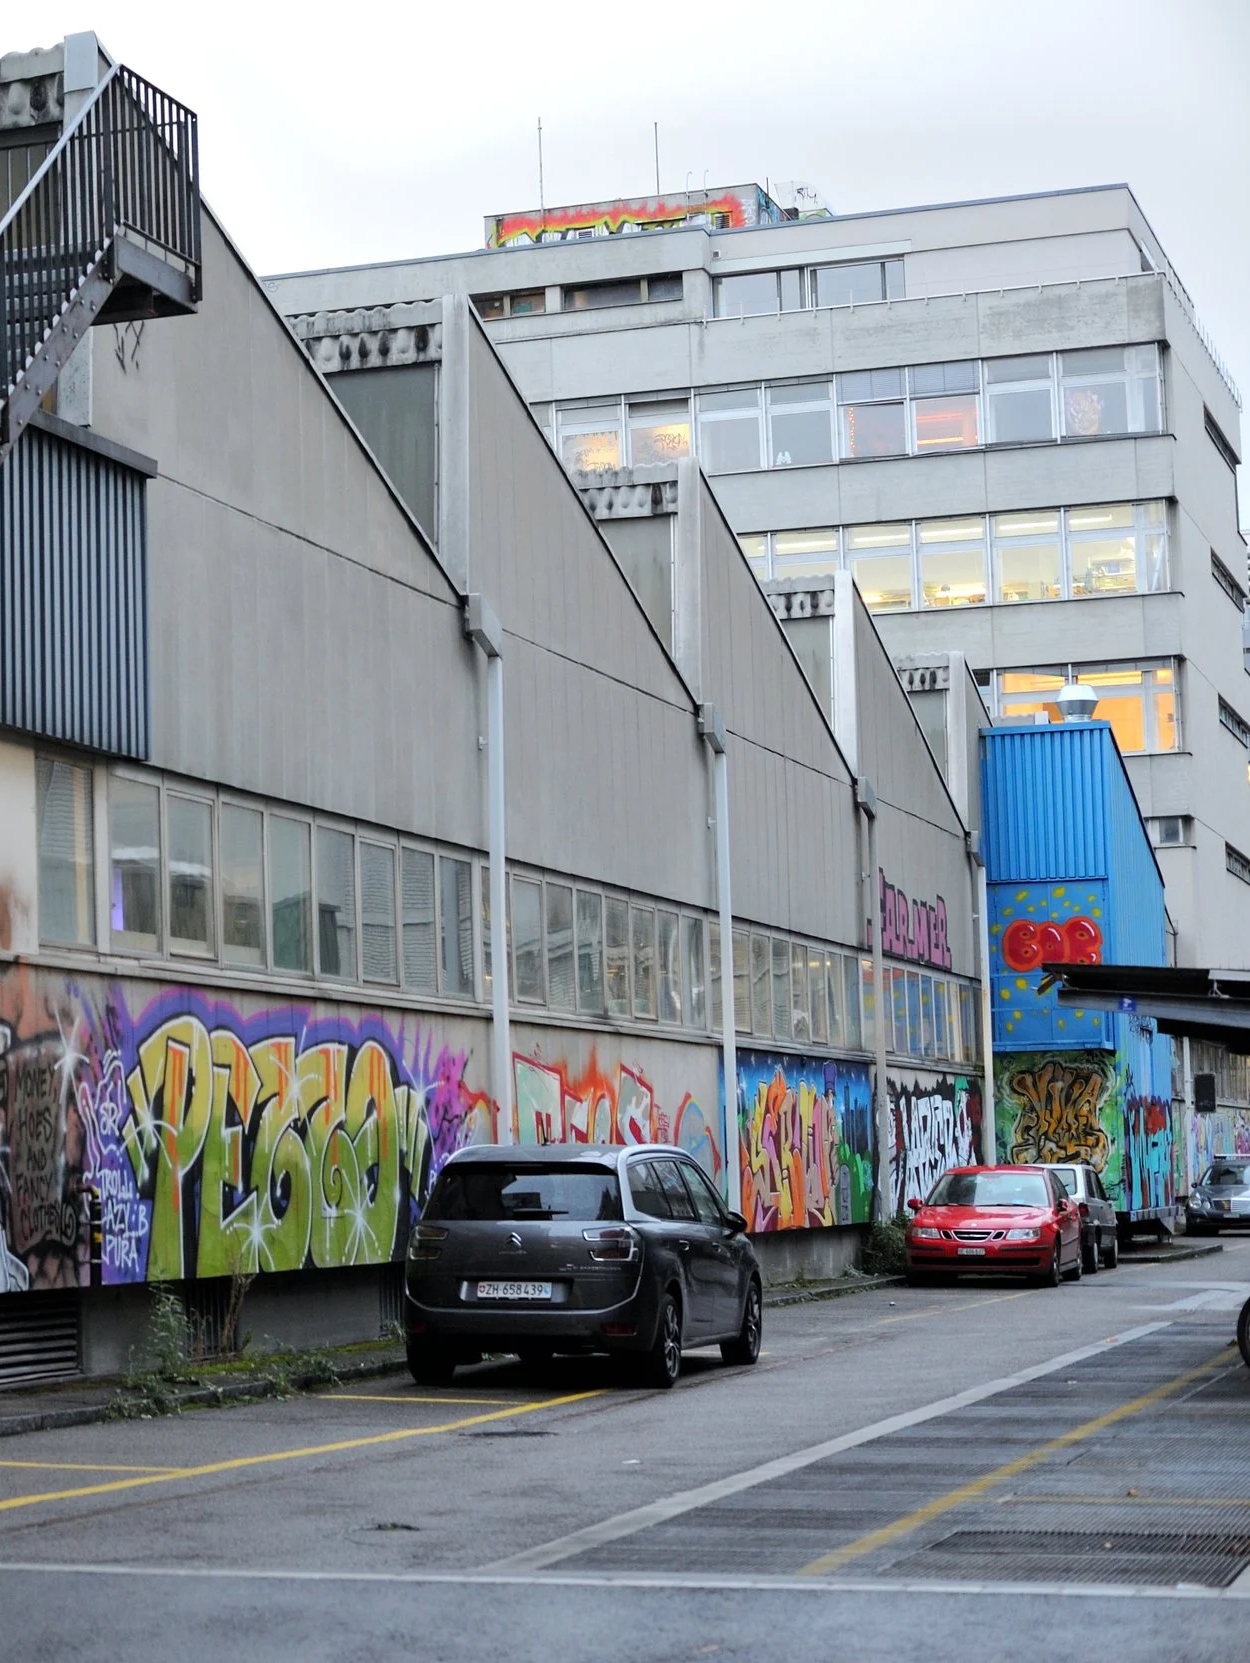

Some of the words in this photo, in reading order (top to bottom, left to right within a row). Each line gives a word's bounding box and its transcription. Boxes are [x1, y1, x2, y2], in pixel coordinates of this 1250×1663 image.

[18, 1106, 53, 1143] HOES
[26, 1148, 48, 1172] AND
[14, 1172, 53, 1207] FANCY
